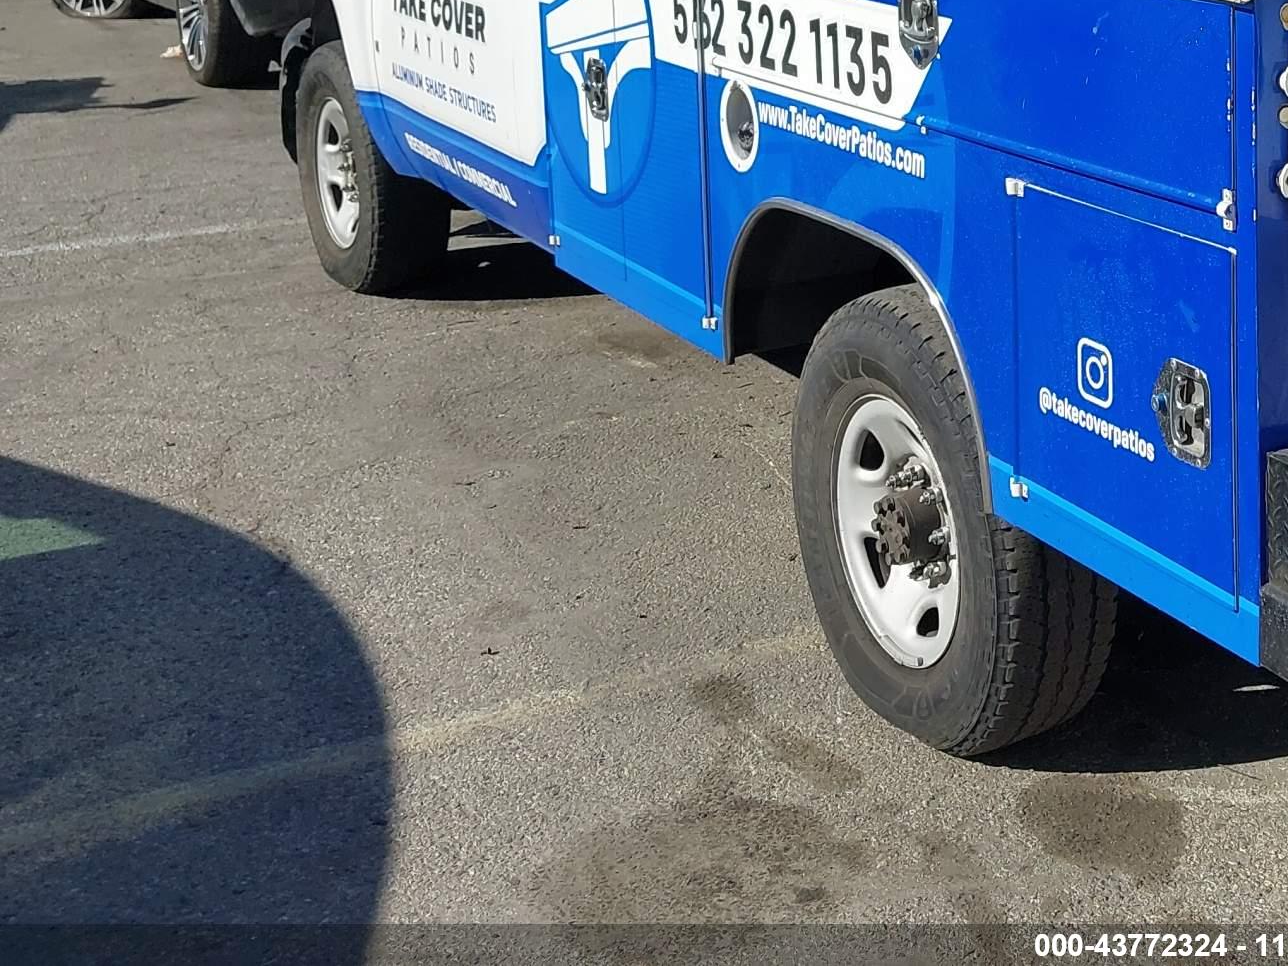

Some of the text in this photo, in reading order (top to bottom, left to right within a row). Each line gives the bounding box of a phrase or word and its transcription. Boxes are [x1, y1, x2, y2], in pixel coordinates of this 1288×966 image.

[401, 25, 475, 75] PATIOS
[737, 0, 798, 77] 322
[809, 18, 892, 104] 1135
[392, 62, 497, 123] ALUMINUM SHADE STRUCTURES
[758, 100, 926, 179] www.TakeCoverPatios.com
[1039, 386, 1155, 462] @takecoverpatios
